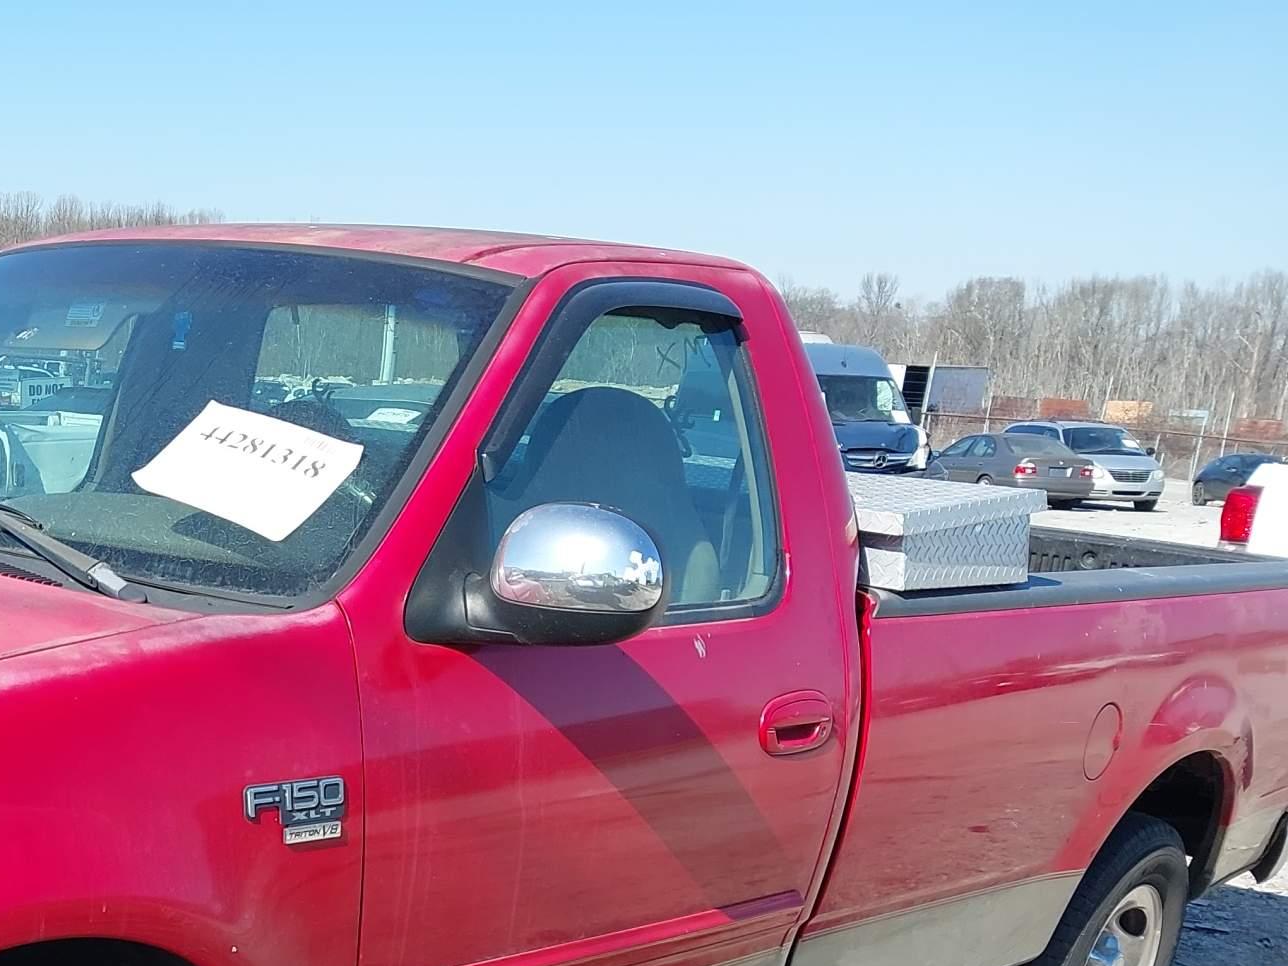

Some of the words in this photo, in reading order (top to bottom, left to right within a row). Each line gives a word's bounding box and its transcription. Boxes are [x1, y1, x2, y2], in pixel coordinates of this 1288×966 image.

[28, 384, 43, 397] DO
[200, 426, 327, 479] 44281318
[291, 806, 337, 822] XLT
[289, 828, 321, 840] TRITON
[322, 823, 339, 837] V8
